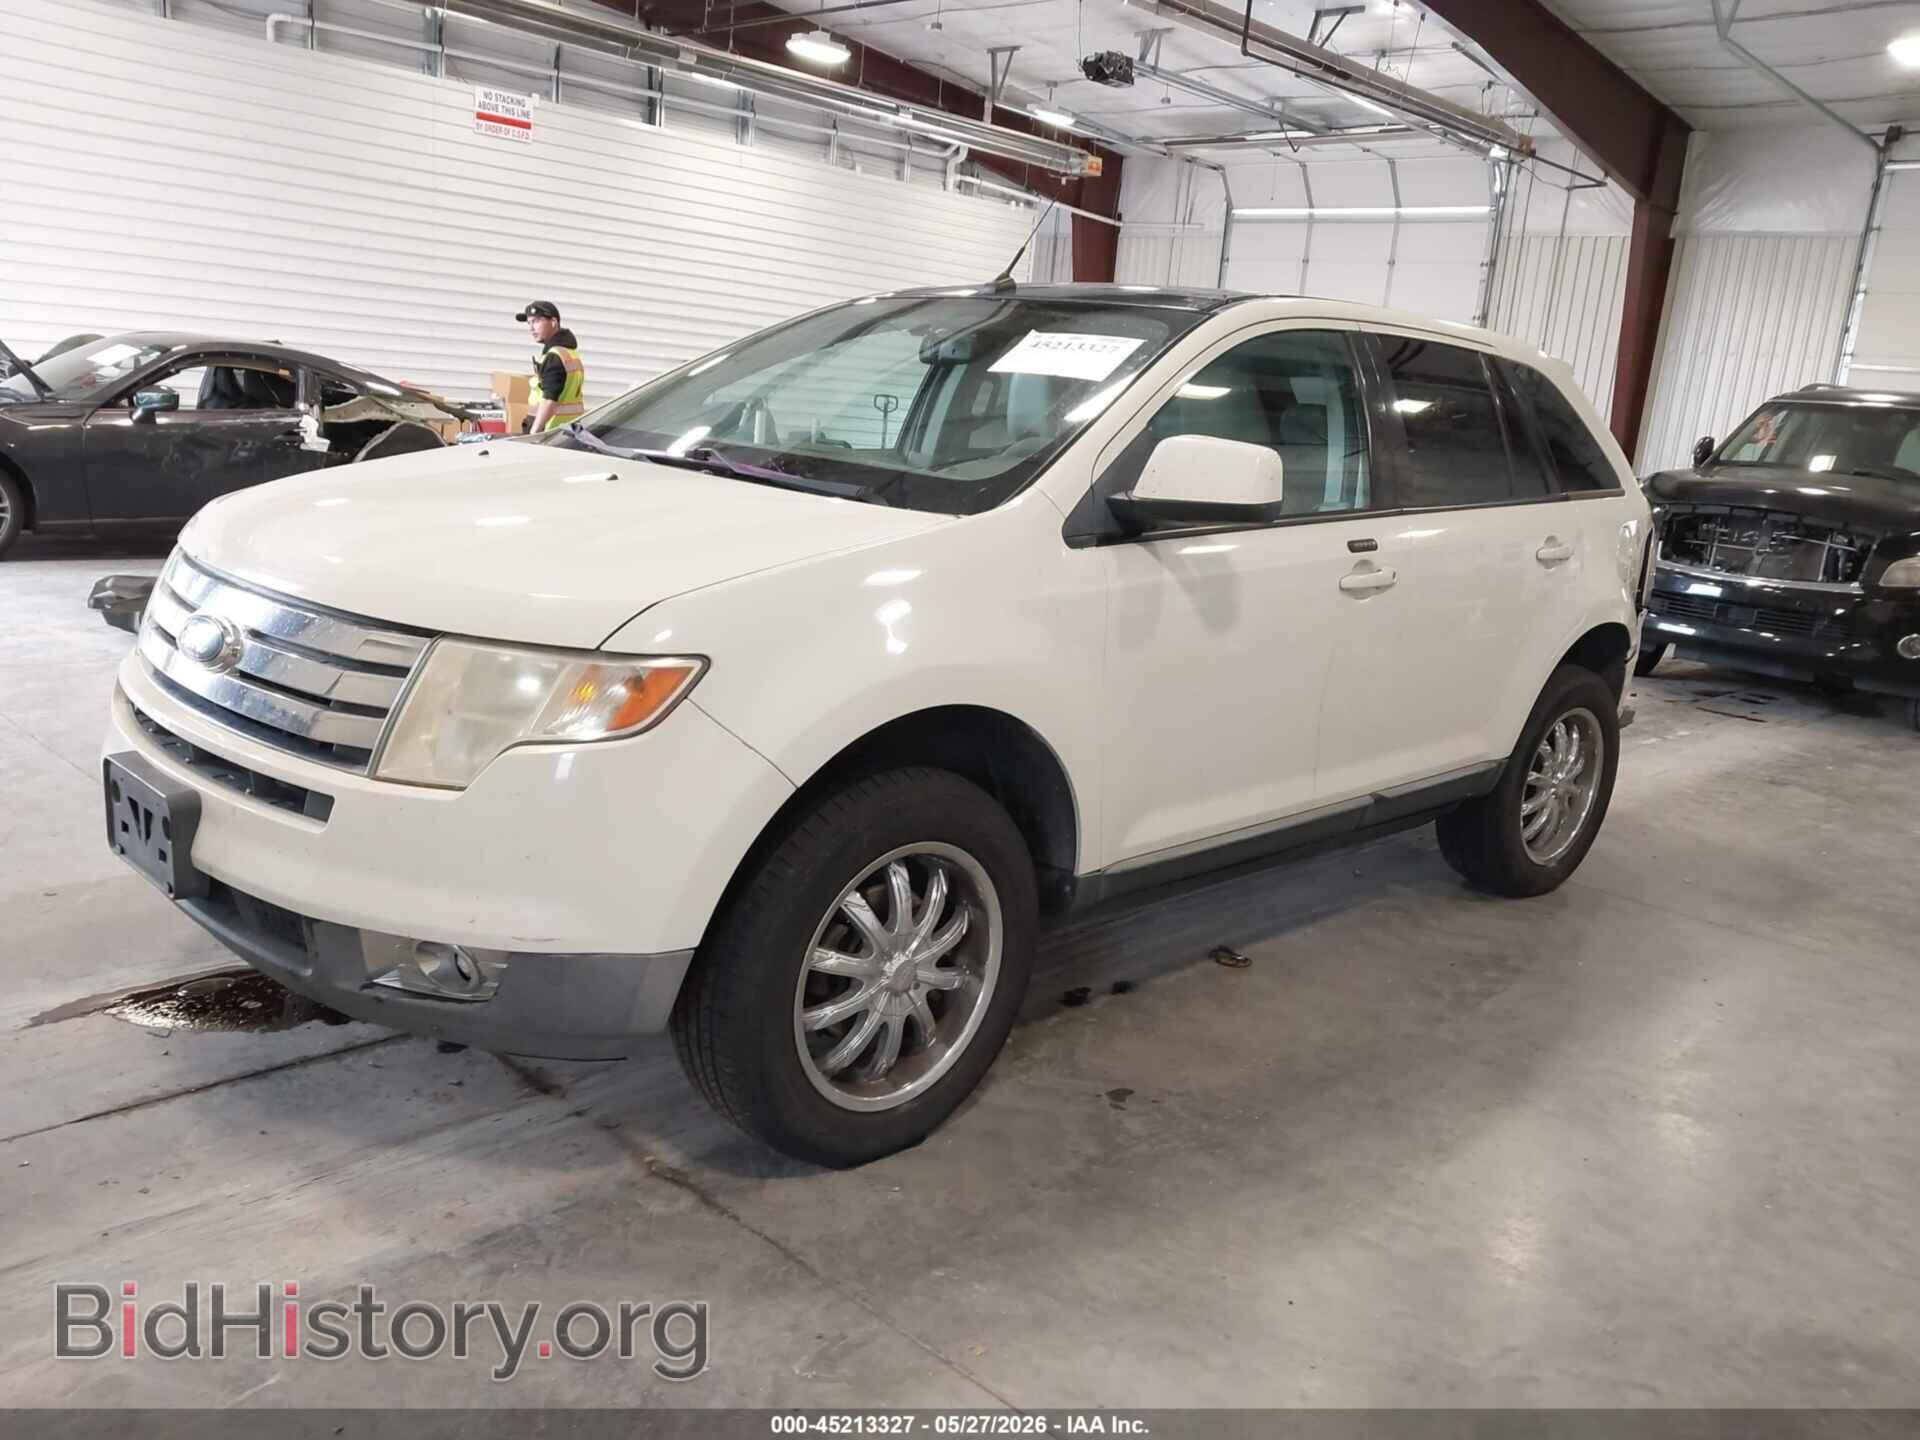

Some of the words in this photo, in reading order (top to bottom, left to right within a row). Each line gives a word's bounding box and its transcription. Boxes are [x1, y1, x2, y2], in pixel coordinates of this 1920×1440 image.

[483, 91, 493, 101] NO
[494, 92, 526, 108] STACKING
[478, 100, 499, 112] ABOVE
[501, 105, 515, 116] THIS
[516, 109, 531, 119] LINE
